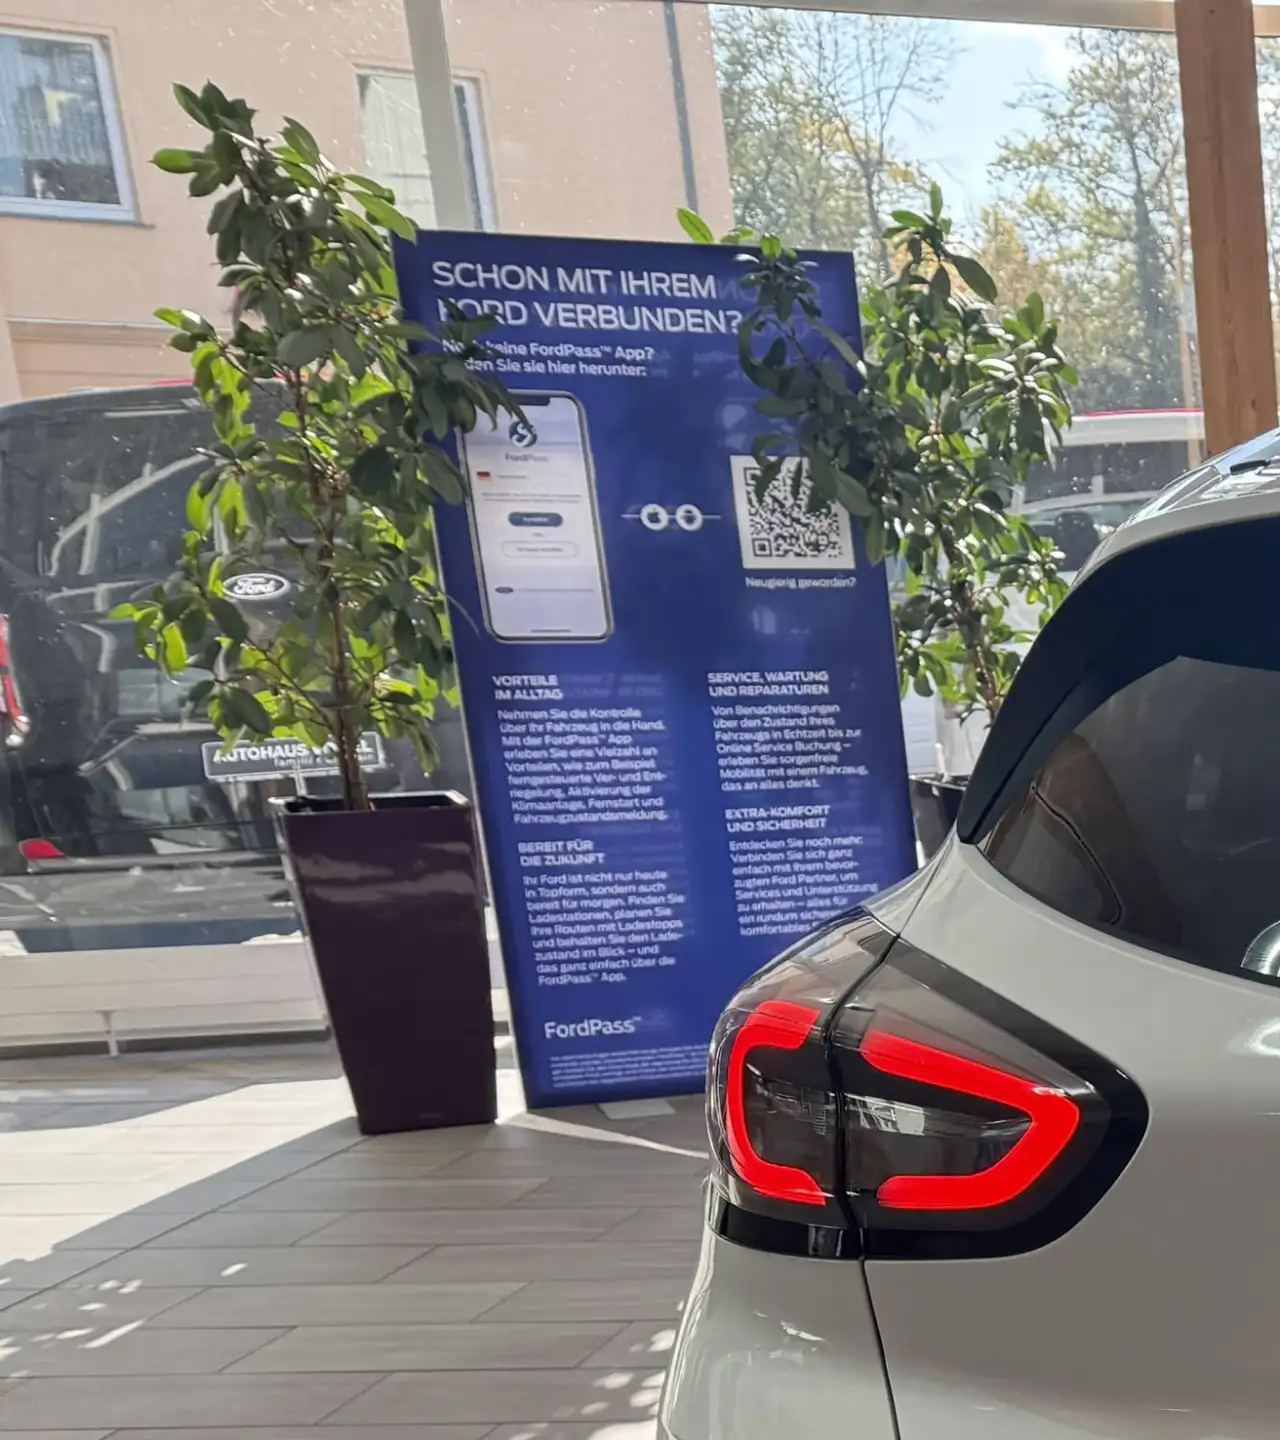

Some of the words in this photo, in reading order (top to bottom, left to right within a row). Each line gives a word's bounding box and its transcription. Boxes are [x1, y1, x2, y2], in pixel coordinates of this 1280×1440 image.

[432, 260, 551, 292] SCHON
[557, 266, 612, 294] MIT
[620, 270, 717, 300] IHREM
[533, 301, 743, 335] VERBUNDEN?
[615, 347, 654, 361] App?
[496, 358, 521, 372] Sie
[523, 360, 544, 373] sie
[547, 360, 576, 375] hier
[492, 675, 558, 686] VORTEILE
[708, 672, 764, 683] SERVICE,
[765, 671, 829, 682] WARTUNG
[495, 690, 511, 699] IM
[514, 689, 563, 700] ALLTAG
[709, 686, 737, 696] UND
[739, 684, 829, 695] REPARATUREN
[497, 710, 548, 719] Nehmen
[550, 709, 567, 719] Sie
[570, 709, 587, 718] die
[589, 708, 642, 718] Kontrolle
[711, 705, 733, 715] Von
[735, 704, 840, 715] Benachrichtigungen
[740, 718, 761, 727] den
[763, 717, 806, 726] Zustand
[809, 716, 835, 725] Ihres
[502, 736, 521, 746] Mit
[523, 736, 542, 745] der
[608, 734, 633, 745] App
[715, 730, 770, 741] Fahrzeugs
[772, 730, 782, 739] in
[784, 729, 826, 739] Echtzeit
[828, 728, 843, 737] bis
[845, 729, 861, 737] zur
[504, 749, 548, 759] erleben
[550, 748, 567, 759] Sie
[570, 749, 594, 758] eine
[595, 746, 640, 757] Vielzahl
[642, 747, 658, 756] an
[716, 744, 752, 754] Online
[753, 743, 792, 752] Service
[795, 741, 841, 751] Buchung
[563, 761, 583, 770] wie
[585, 761, 609, 770] zum
[611, 759, 656, 770] Beispiel
[718, 756, 758, 766] erleben
[760, 755, 777, 764] Sie
[780, 753, 838, 764] sorgenfreie
[720, 768, 766, 778] Mobilität
[768, 767, 784, 776] mit
[786, 767, 818, 776] einem
[722, 781, 742, 791] das
[744, 782, 758, 790] an
[759, 780, 785, 789] alles
[786, 778, 819, 788] denkt.
[725, 805, 830, 819] EXTRA-KOMFORT
[727, 822, 754, 832] UND
[756, 818, 827, 831] SICHERHEIT
[518, 841, 564, 853] BEREIT
[567, 839, 593, 851] FÜR
[729, 840, 785, 851] Entdecken
[787, 838, 803, 848] Sie
[805, 837, 831, 846] noch
[520, 856, 541, 866] DIE
[544, 853, 605, 865] ZUKUNFT
[730, 852, 785, 863] Verbinden
[787, 850, 803, 860] Sie
[805, 849, 825, 858] sich
[828, 849, 853, 859] ganz
[523, 876, 538, 885] Ihr
[540, 875, 566, 884] Ford
[568, 874, 583, 883] ist
[584, 873, 612, 883] nicht
[614, 873, 632, 881] nur
[635, 871, 667, 880] heute
[734, 877, 770, 888] zugten
[772, 875, 796, 885] Ford
[525, 888, 536, 898] in
[590, 885, 636, 894] sondern
[638, 882, 666, 892] auch
[736, 890, 781, 900] Services
[782, 888, 802, 897] und
[804, 883, 878, 895] Unterstützung
[526, 901, 559, 911] bereit
[562, 899, 577, 909] für
[628, 895, 665, 905] Finden
[667, 894, 685, 903] Sie
[737, 904, 750, 912] zu
[752, 900, 795, 910] erhalten
[807, 897, 831, 907] alles
[833, 896, 848, 905] für
[614, 909, 652, 920] planen
[654, 907, 672, 916] Sie
[739, 915, 755, 924] ein
[757, 912, 798, 922] rundum
[530, 925, 552, 936] Ihre
[554, 924, 595, 934] Routen
[597, 923, 616, 932] mit
[618, 920, 683, 931] Ladestopps
[534, 950, 580, 961] zustand
[582, 949, 596, 958] im
[598, 947, 625, 957] Blick
[637, 945, 659, 955] und
[536, 963, 558, 974] das
[560, 962, 587, 973] ganz
[588, 959, 629, 970] einfach
[658, 956, 675, 966] die
